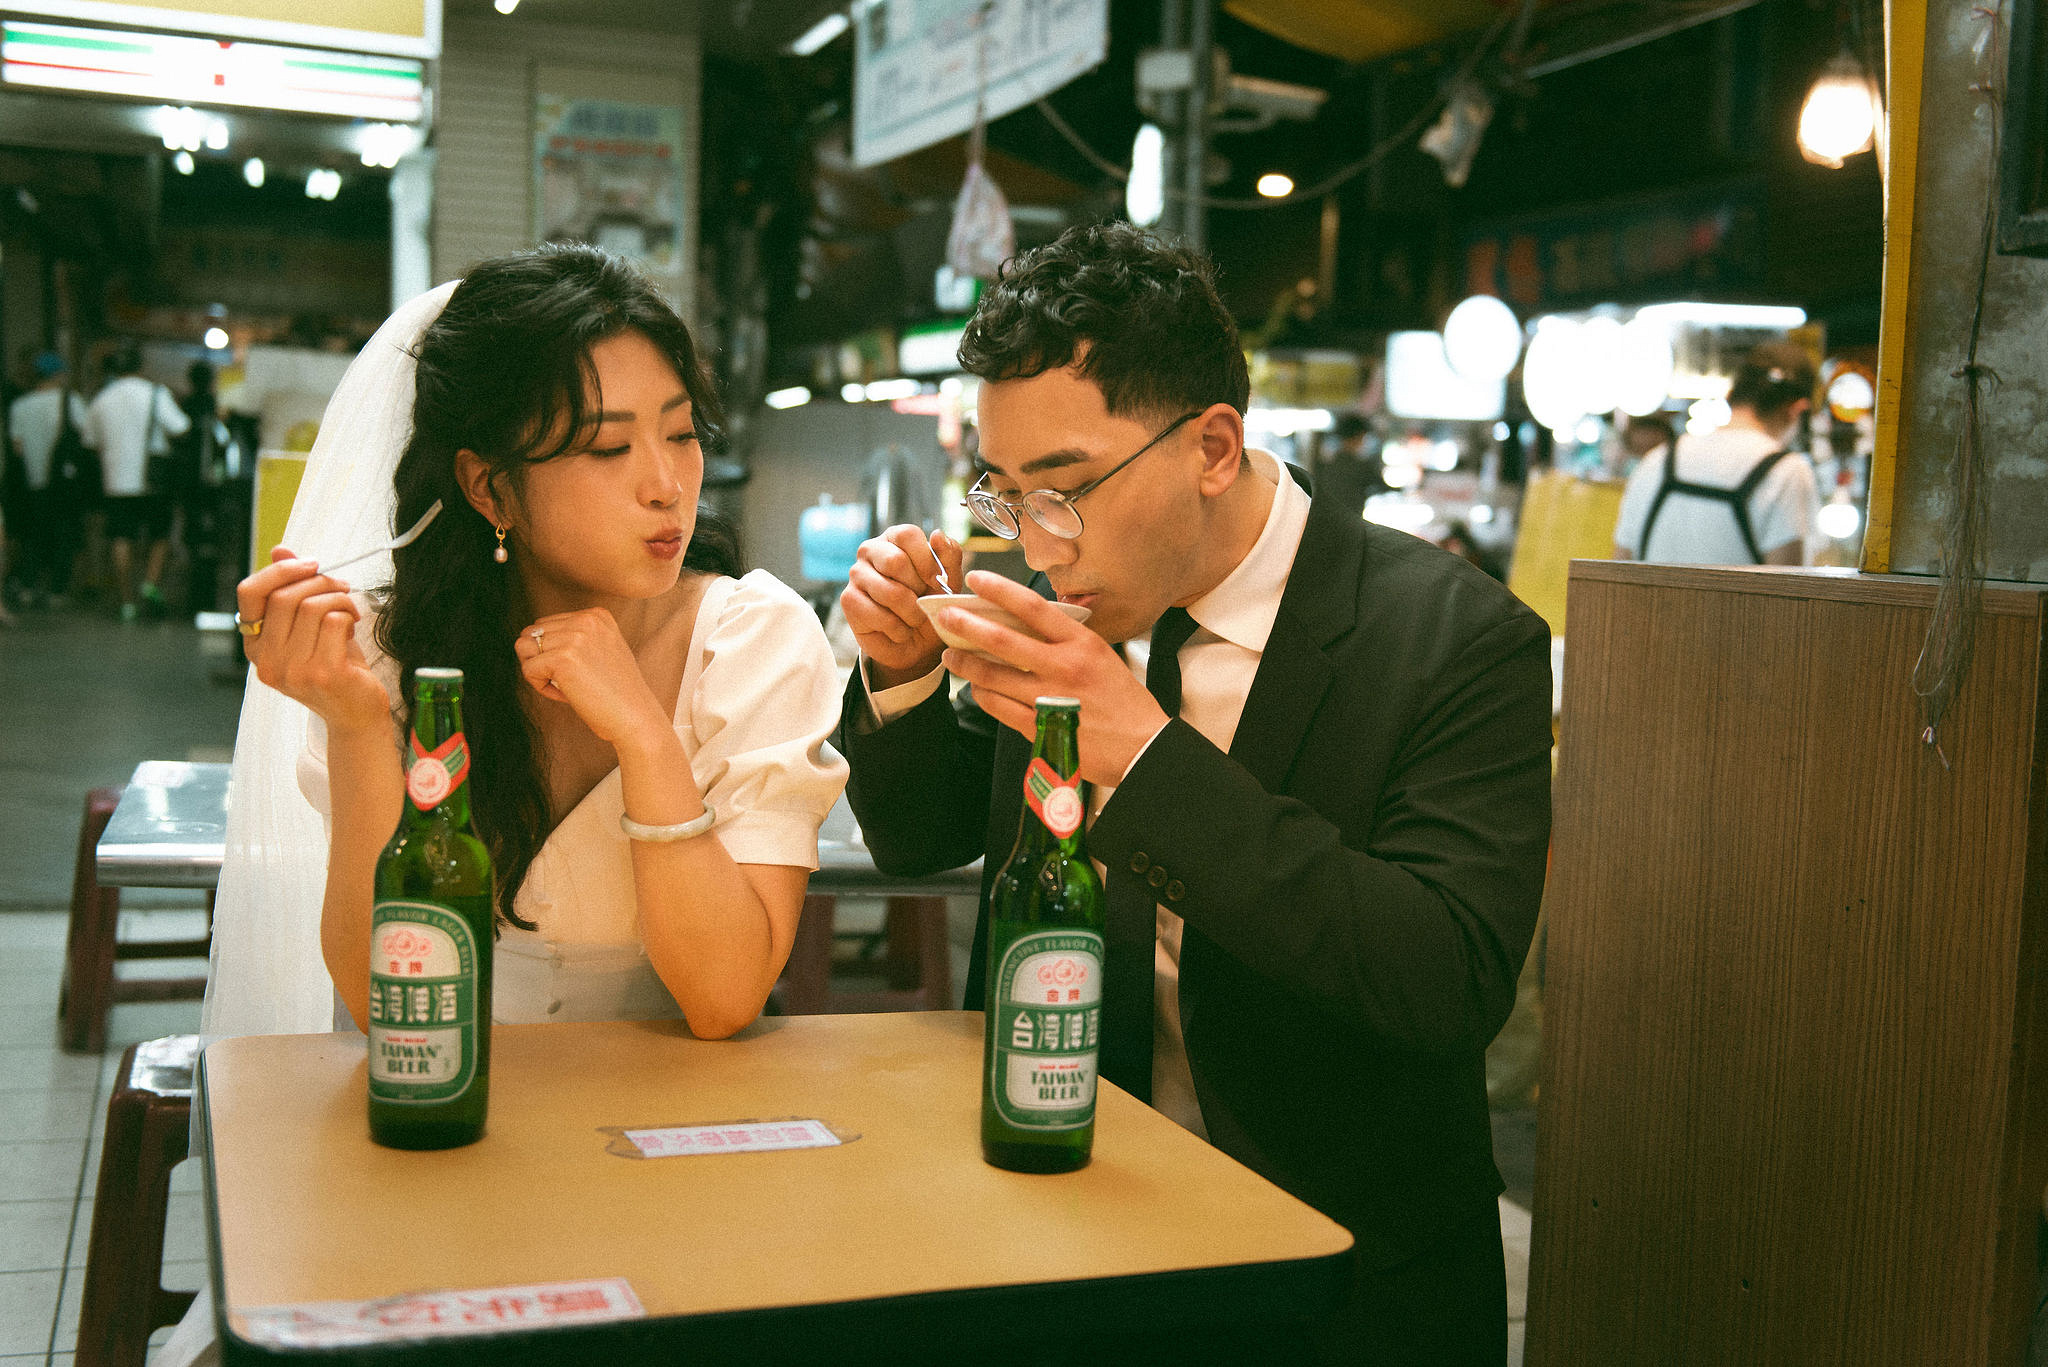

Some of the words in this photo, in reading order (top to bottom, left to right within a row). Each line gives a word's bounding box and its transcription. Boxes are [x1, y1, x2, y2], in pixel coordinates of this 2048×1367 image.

[371, 983, 458, 1023] 台灣啤酒
[1012, 1009, 1099, 1051] 台灣啤酒
[381, 1043, 437, 1058] TAIWAN
[387, 1060, 431, 1075] BEER
[1031, 1070, 1085, 1085] TAIWAN
[1039, 1086, 1080, 1100] BEER
